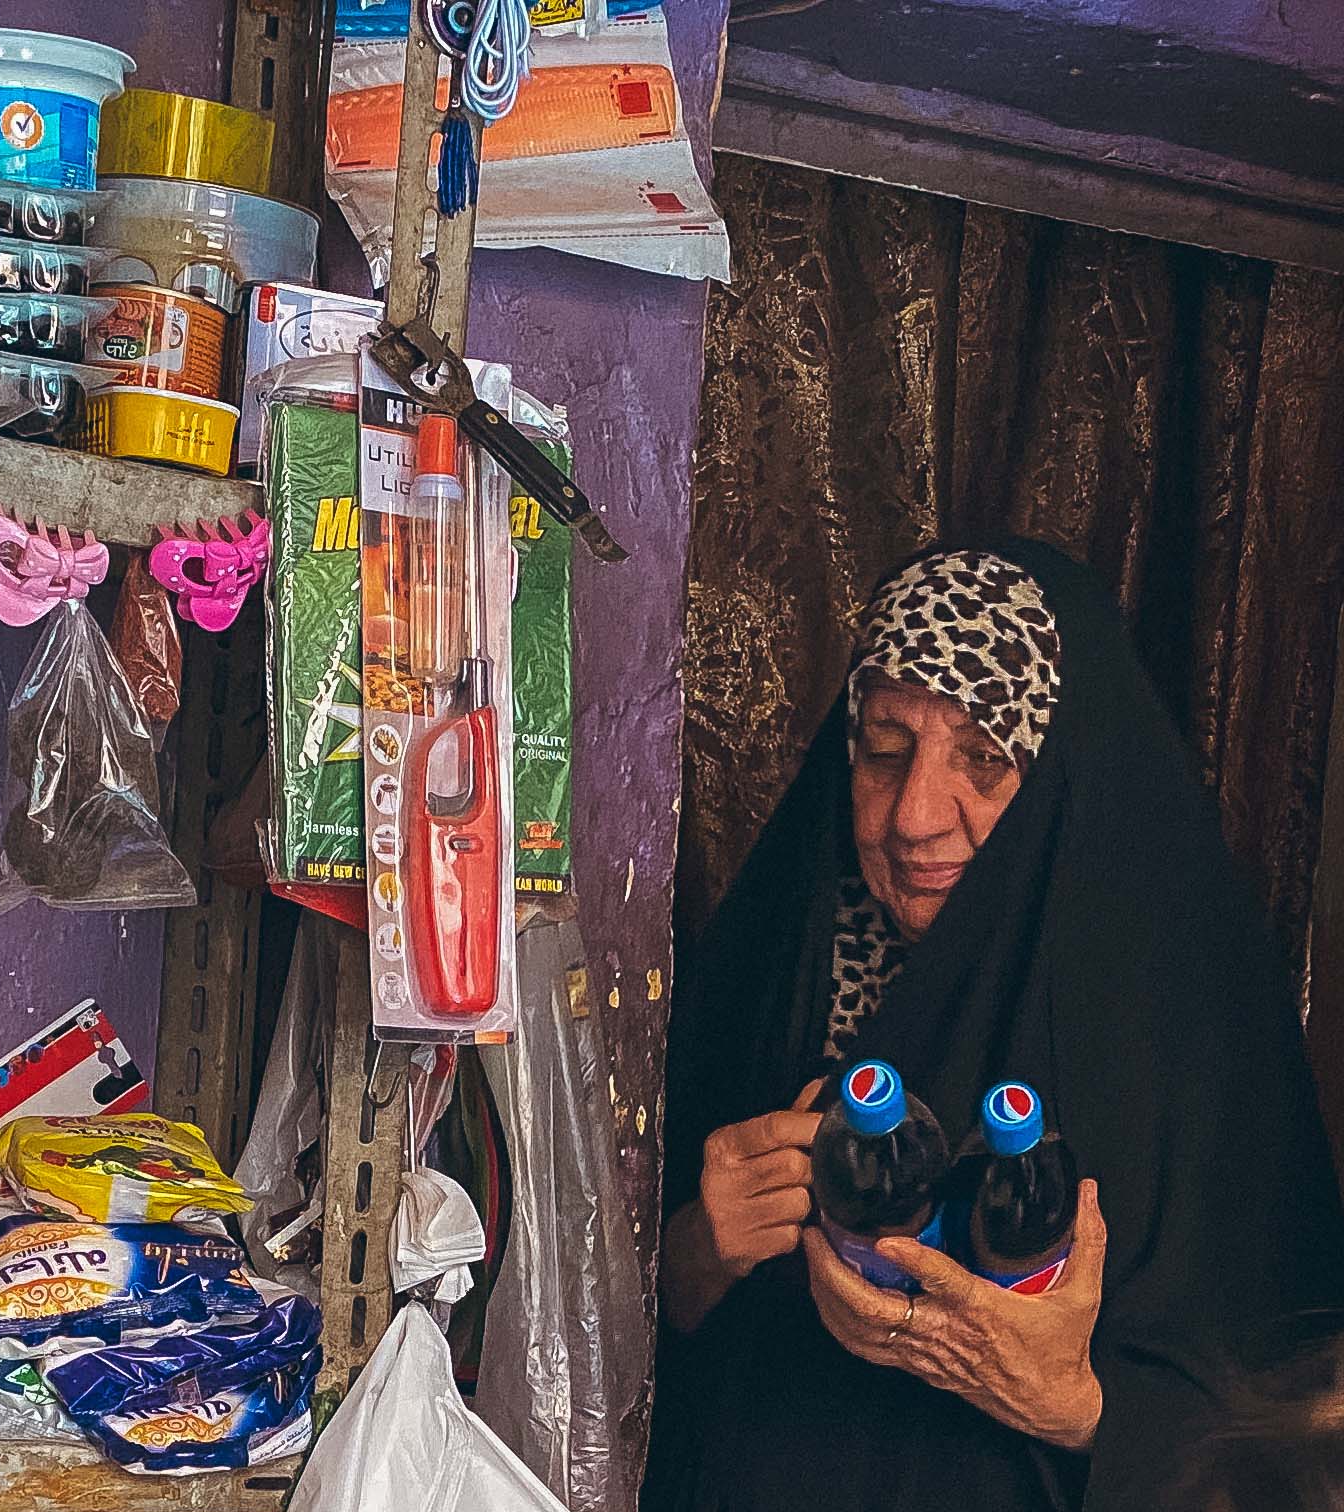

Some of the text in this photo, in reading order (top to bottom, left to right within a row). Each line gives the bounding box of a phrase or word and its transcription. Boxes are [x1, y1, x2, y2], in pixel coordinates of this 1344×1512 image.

[520, 733, 568, 749] QUALITY
[519, 748, 568, 763] ORIGINAL
[302, 821, 360, 837] Harmless
[307, 862, 332, 879] HAVE
[534, 878, 564, 894] WORLD
[12, 1239, 69, 1260] Family
